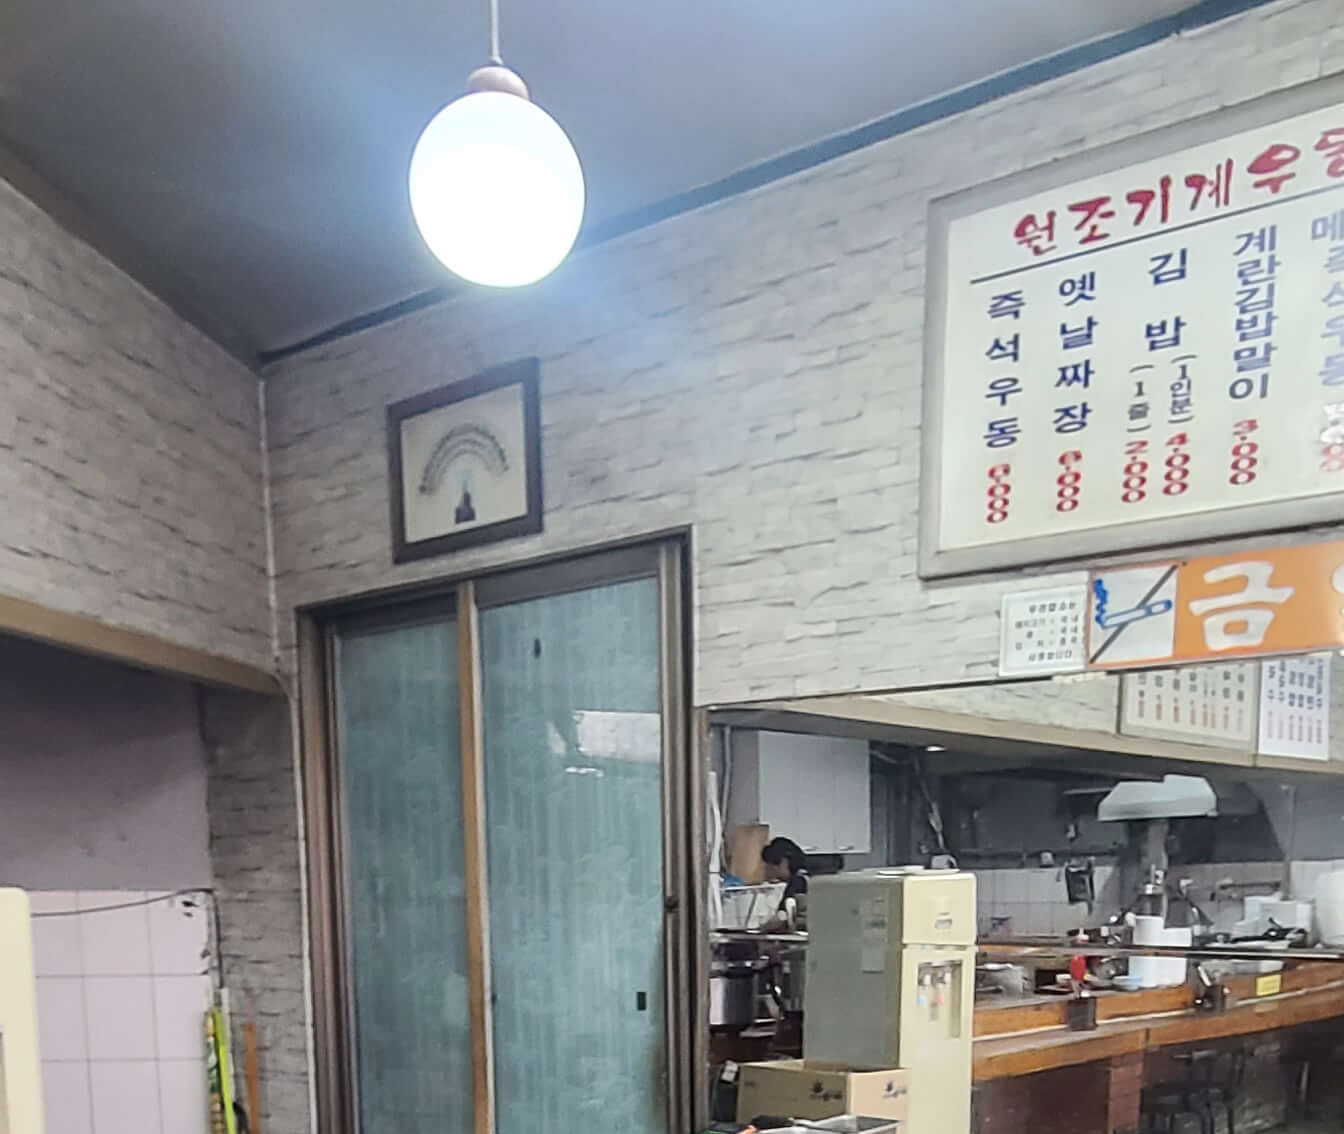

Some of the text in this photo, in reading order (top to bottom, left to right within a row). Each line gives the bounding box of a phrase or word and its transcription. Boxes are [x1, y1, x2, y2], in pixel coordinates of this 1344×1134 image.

[983, 289, 1027, 448] 즉석우동
[1052, 270, 1099, 434] 옛날짜장
[1145, 247, 1188, 351] 김밥
[1229, 224, 1281, 400] 계란김밥말이
